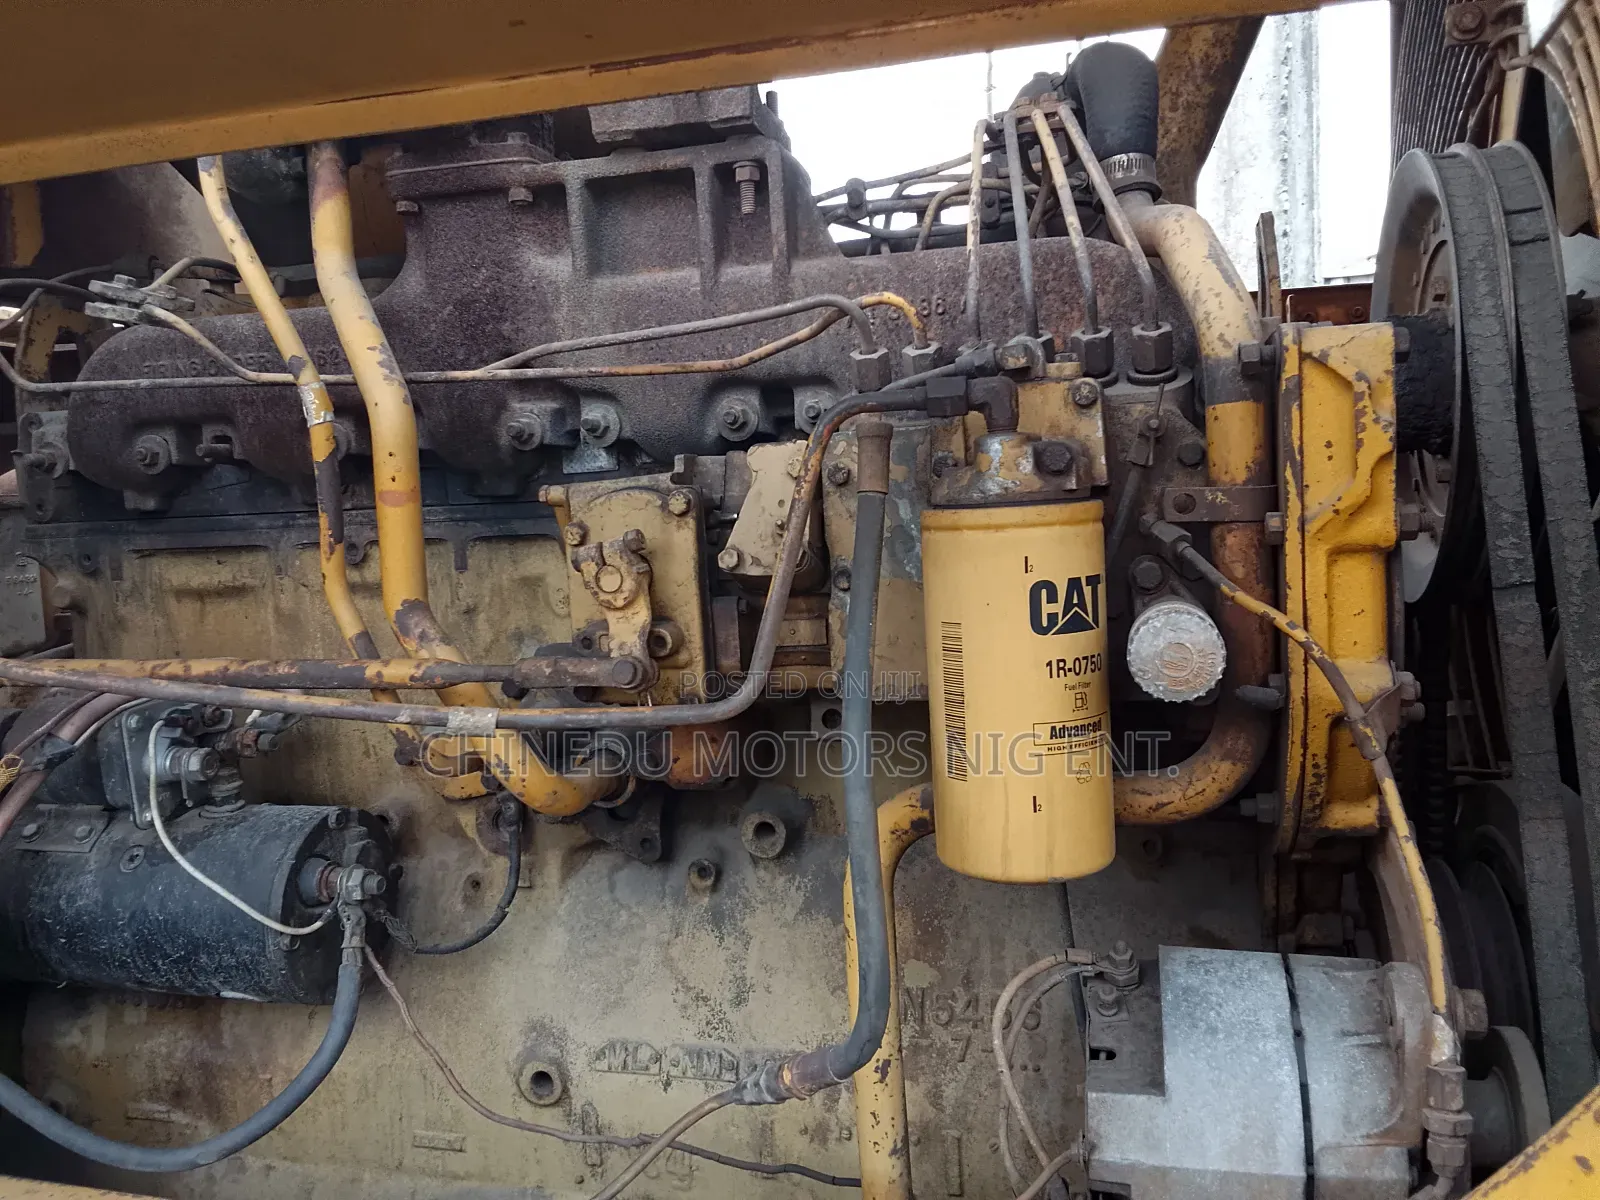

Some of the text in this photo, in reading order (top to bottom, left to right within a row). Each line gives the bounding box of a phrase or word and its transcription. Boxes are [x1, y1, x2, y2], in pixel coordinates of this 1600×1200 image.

[1029, 573, 1102, 636] CAT
[1045, 653, 1102, 679] 1R-0750
[1064, 681, 1092, 692] Fuel Filter
[1049, 717, 1102, 740] Advanced
